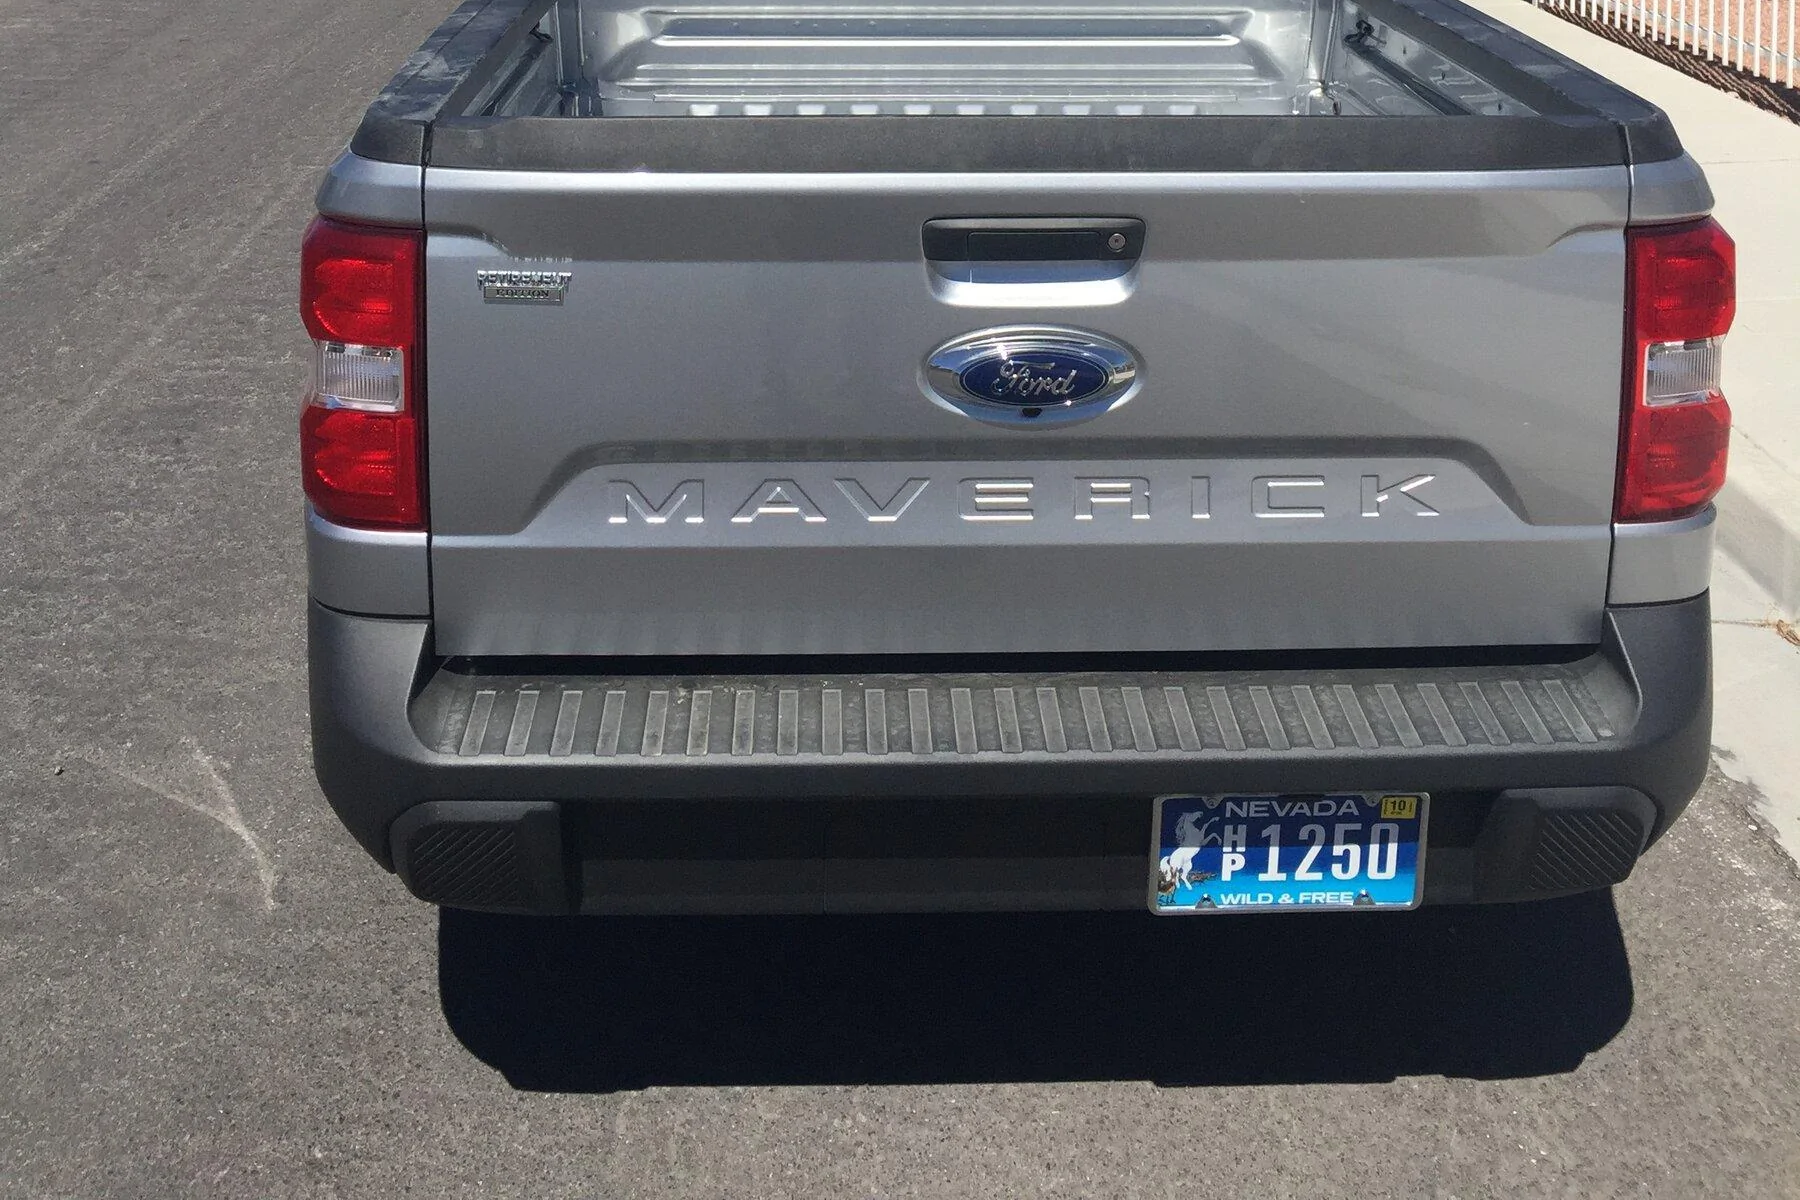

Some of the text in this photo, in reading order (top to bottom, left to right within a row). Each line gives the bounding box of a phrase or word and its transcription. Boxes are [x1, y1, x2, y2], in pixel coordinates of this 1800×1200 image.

[496, 288, 549, 299] EDITION
[990, 360, 1077, 396] Ford
[608, 474, 1440, 524] MAVERICK
[1225, 800, 1359, 818] NEVADA
[1391, 800, 1407, 811] 10
[1258, 823, 1400, 881] 1250
[1220, 892, 1353, 905] WILD & FREE
